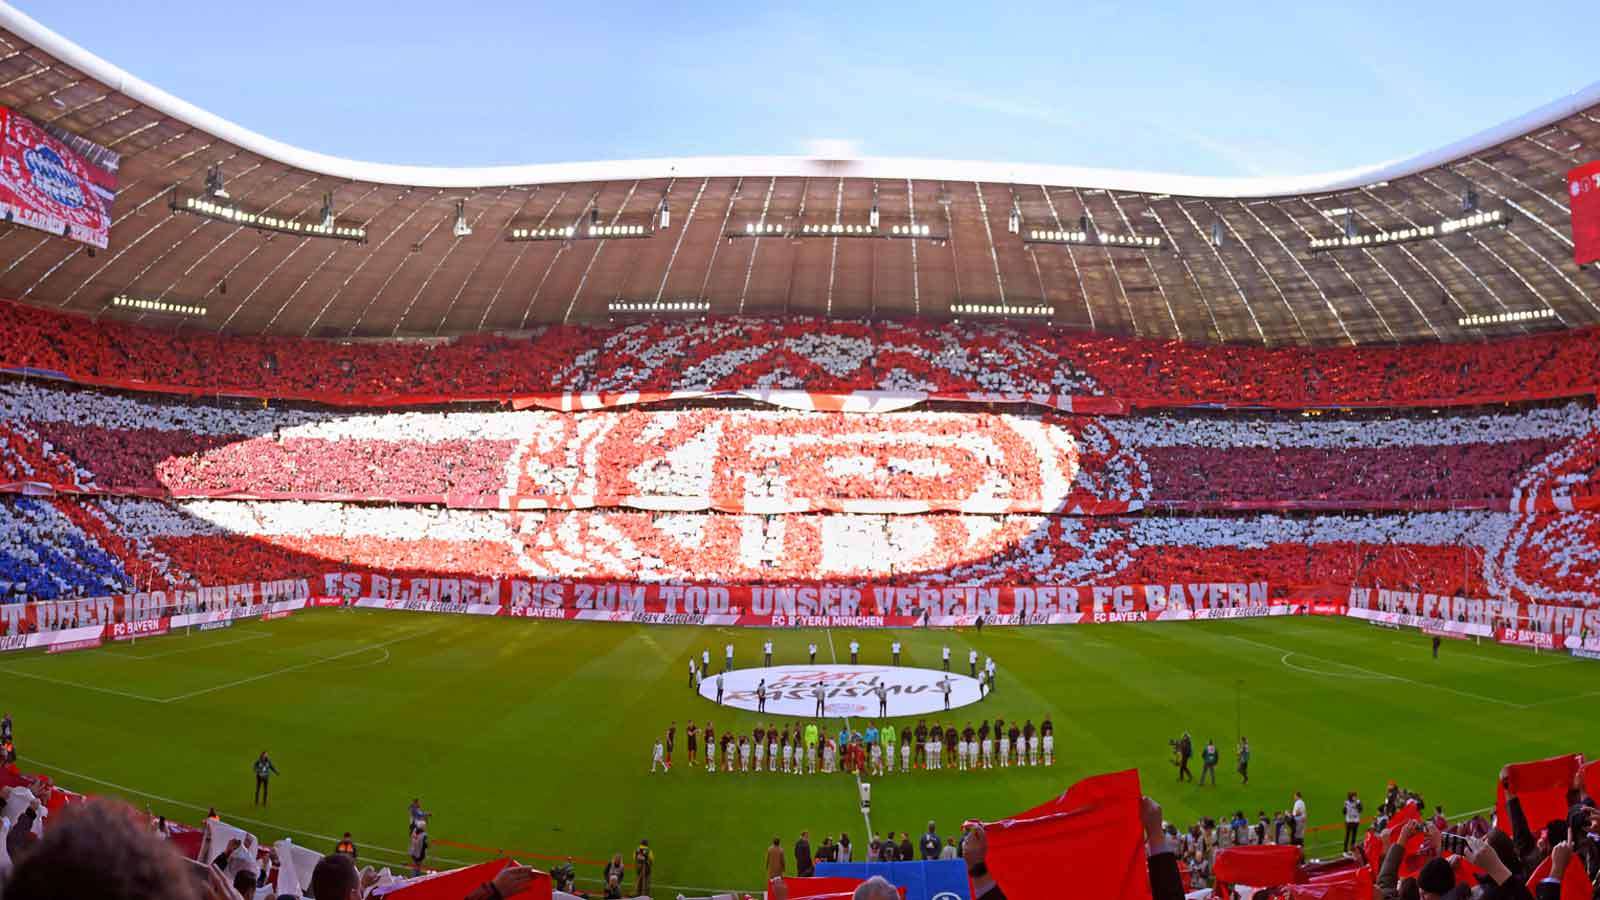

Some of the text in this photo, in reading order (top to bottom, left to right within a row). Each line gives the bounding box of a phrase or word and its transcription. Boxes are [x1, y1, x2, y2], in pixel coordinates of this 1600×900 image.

[370, 574, 501, 607] BLEIBEN
[511, 580, 564, 608] BIS
[575, 582, 646, 612] ZUM
[751, 586, 862, 617] UNSER
[873, 587, 1000, 617] VEREIN
[1014, 586, 1079, 616] DER
[1093, 584, 1134, 613] FC
[1145, 582, 1268, 611] BAYERN
[510, 606, 565, 618] FC BAYERN
[1094, 612, 1107, 622] FC
[771, 615, 786, 626] FC
[113, 619, 160, 636] FC BAYERN
